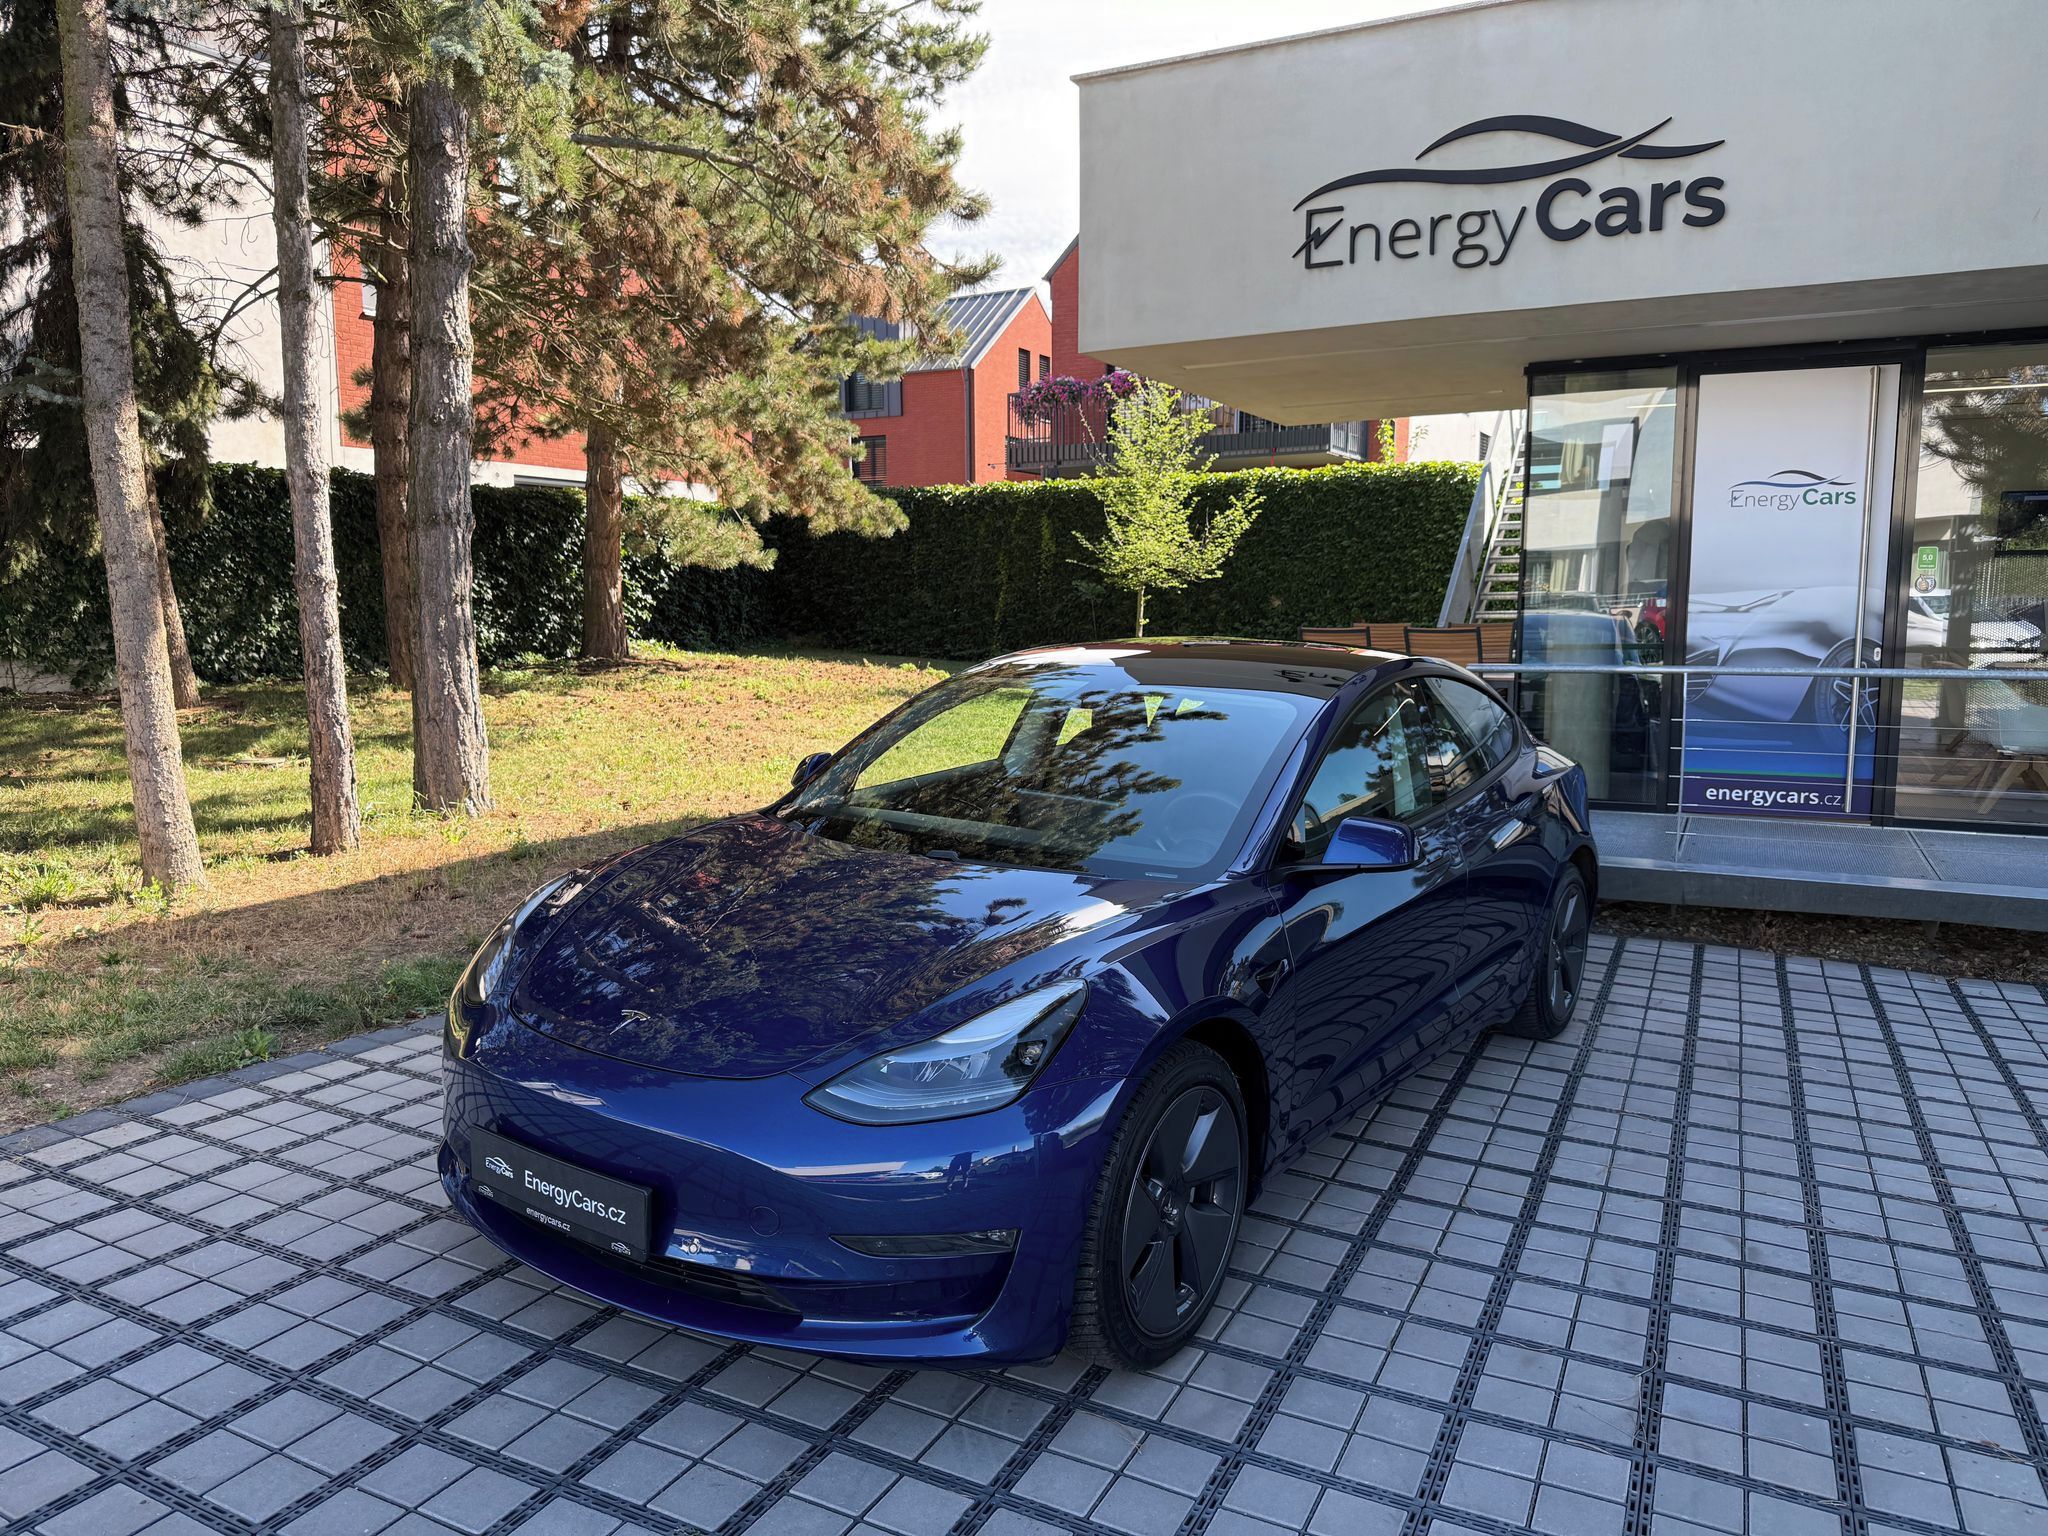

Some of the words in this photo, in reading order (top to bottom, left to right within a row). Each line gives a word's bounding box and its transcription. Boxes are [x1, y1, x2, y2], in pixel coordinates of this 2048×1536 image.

[1706, 787, 1842, 806] energycars.cz
[524, 1170, 626, 1224] EnergyCars.cz
[526, 1207, 571, 1231] energycars.cz
